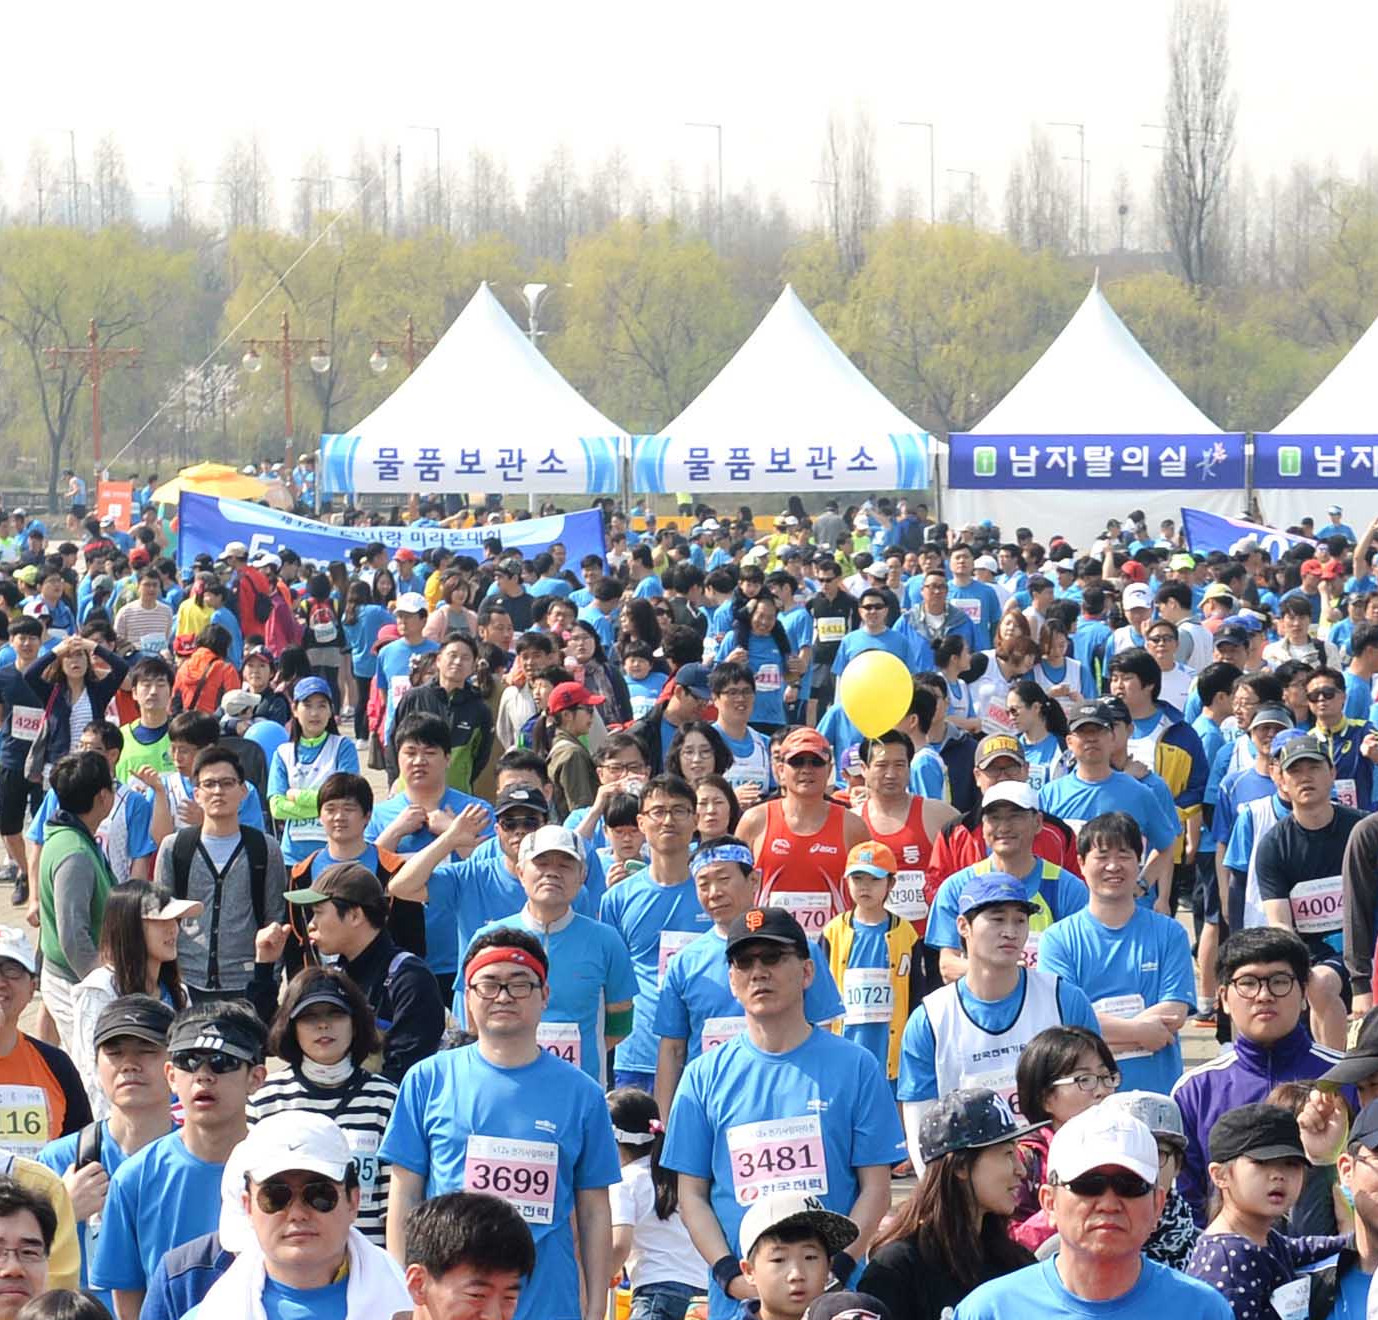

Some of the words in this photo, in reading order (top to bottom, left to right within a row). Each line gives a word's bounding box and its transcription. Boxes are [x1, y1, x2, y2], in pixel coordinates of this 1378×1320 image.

[373, 446, 568, 482] 물품보관소
[683, 445, 878, 481] 물품보관소
[1008, 444, 1187, 479] 남자탈의실
[848, 986, 891, 1005] 10727
[738, 1143, 819, 1179] 3481
[470, 1163, 551, 1196] 3699
[760, 1177, 823, 1197] 한국전력
[517, 1204, 551, 1220] 전력
